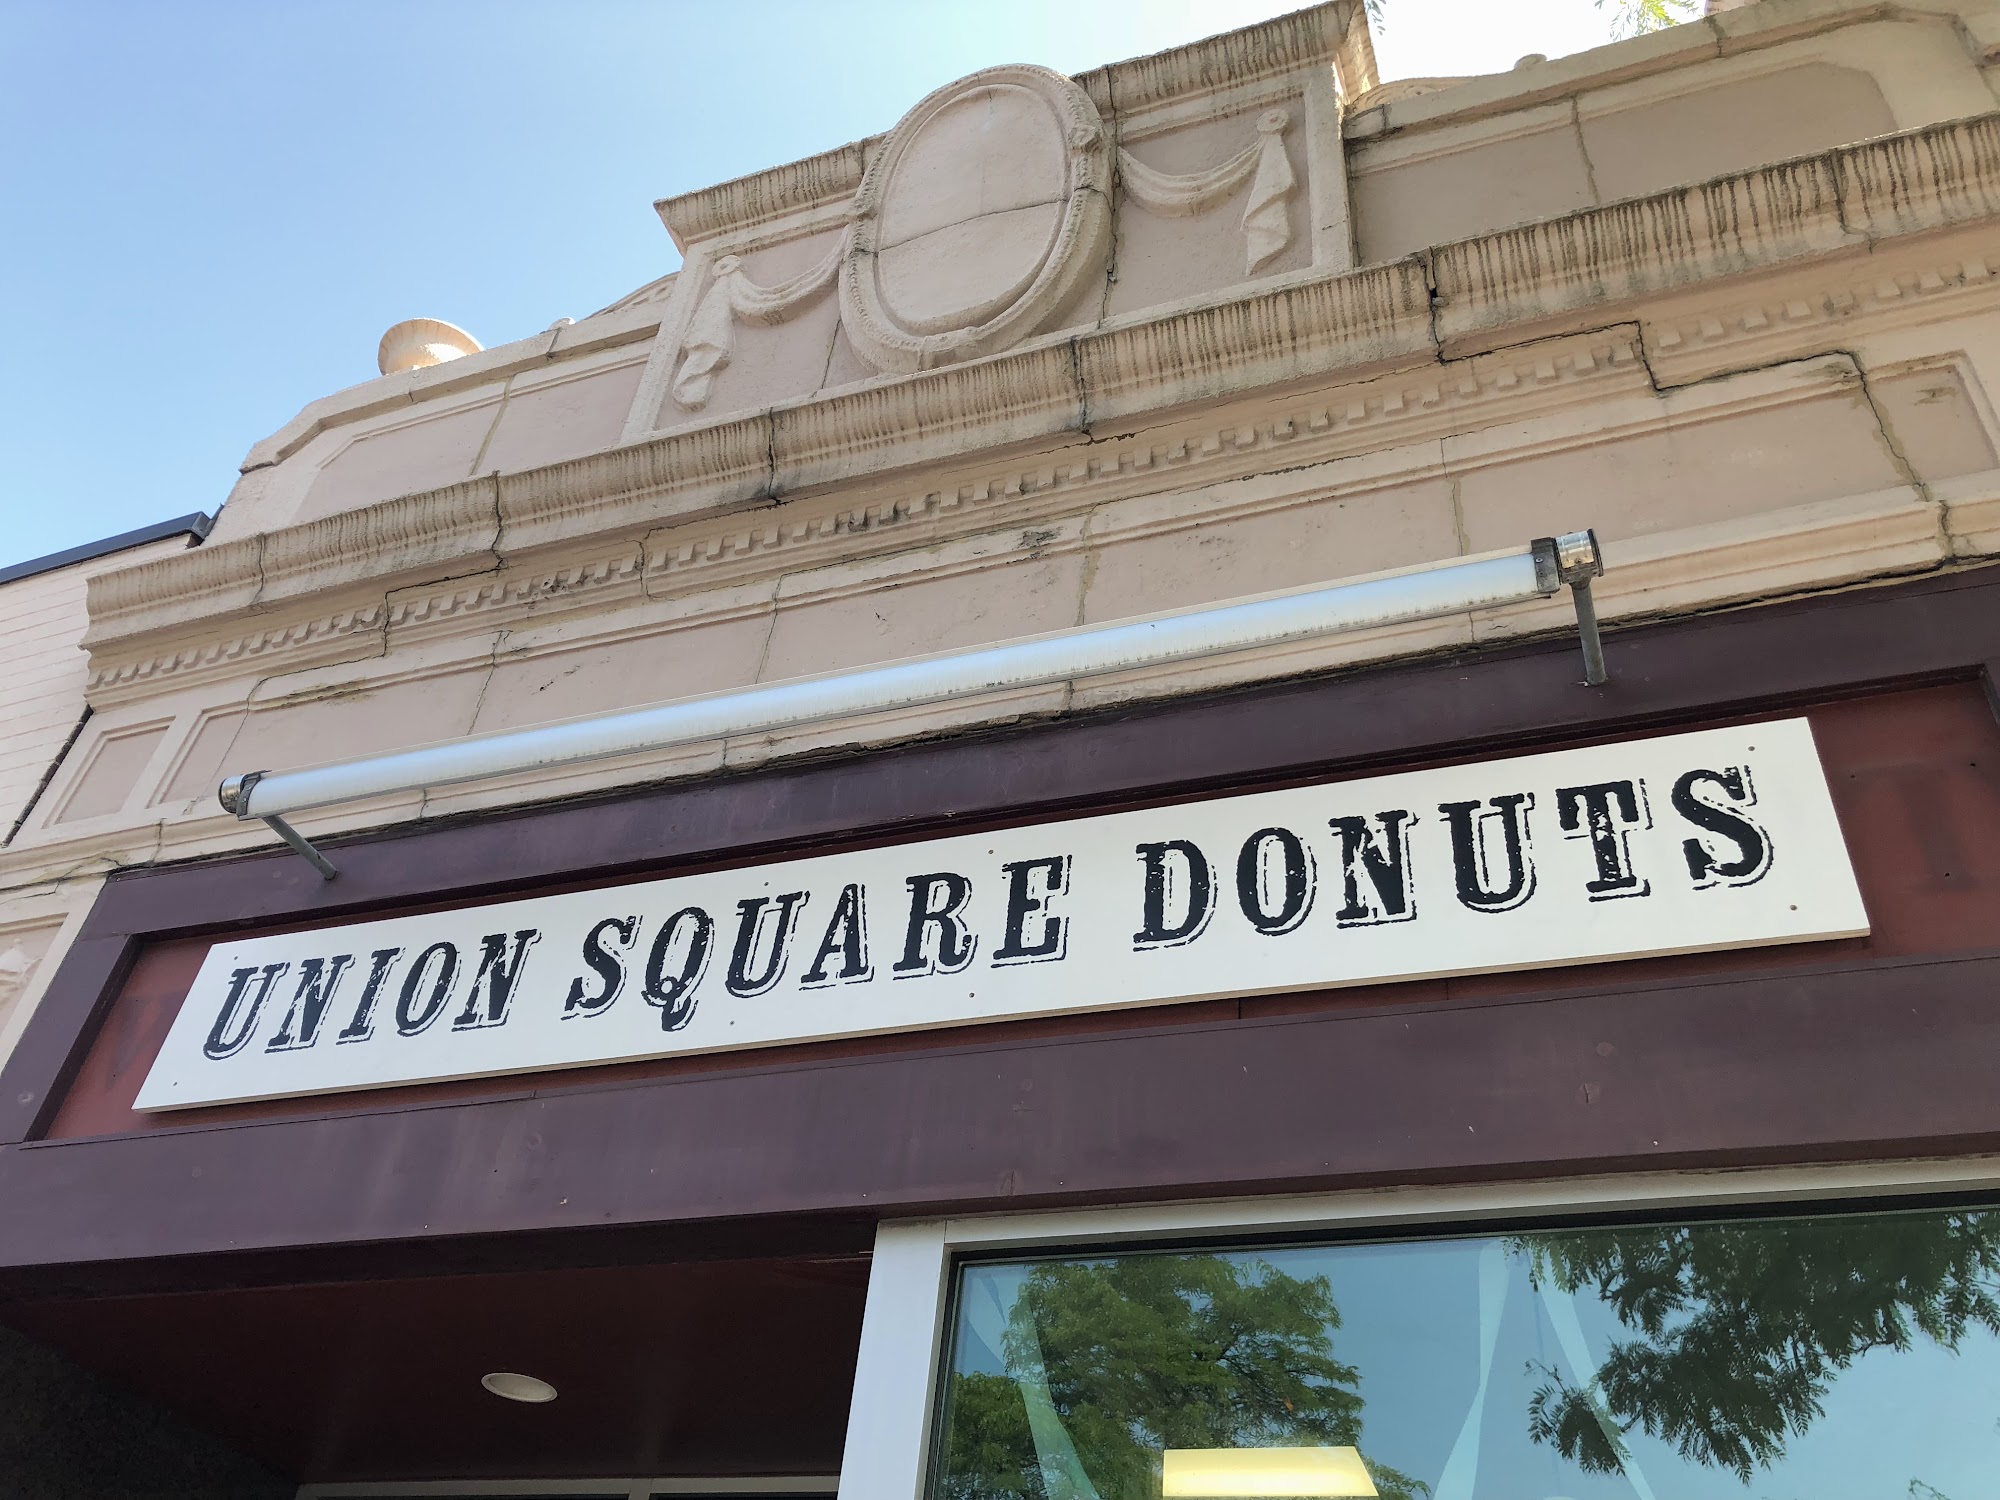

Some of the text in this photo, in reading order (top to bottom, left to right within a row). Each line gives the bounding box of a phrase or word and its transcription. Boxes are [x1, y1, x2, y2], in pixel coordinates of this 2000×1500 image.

[203, 929, 540, 1060] UNION
[563, 855, 1072, 1032] SQUARE
[1133, 765, 1775, 951] DONUTS
